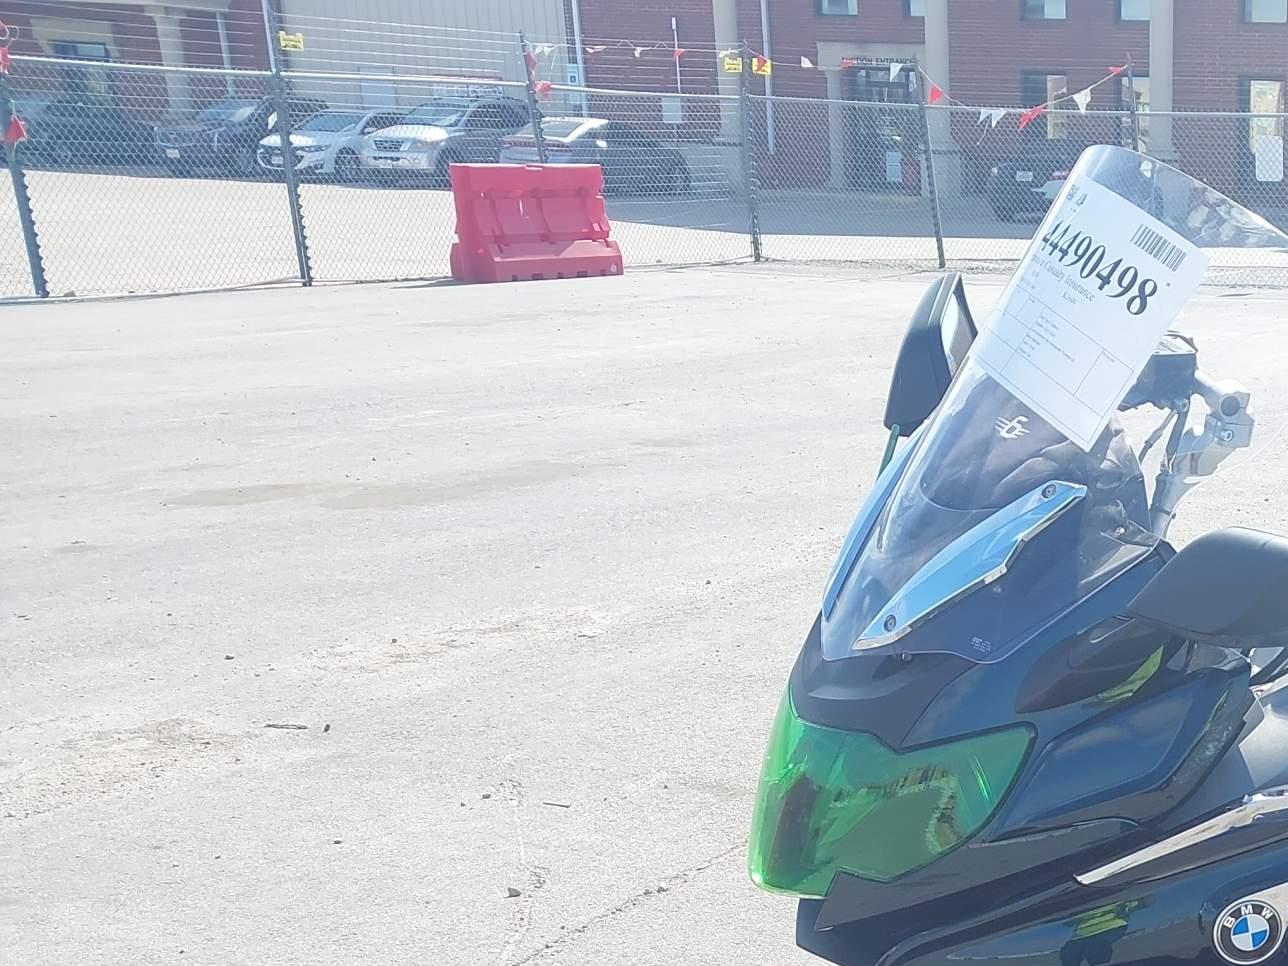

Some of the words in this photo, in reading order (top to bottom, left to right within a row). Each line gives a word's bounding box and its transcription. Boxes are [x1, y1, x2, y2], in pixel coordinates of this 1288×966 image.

[1041, 219, 1158, 315] 44490498
[1064, 273, 1096, 301] Insurance
[1223, 904, 1274, 929] BMW
